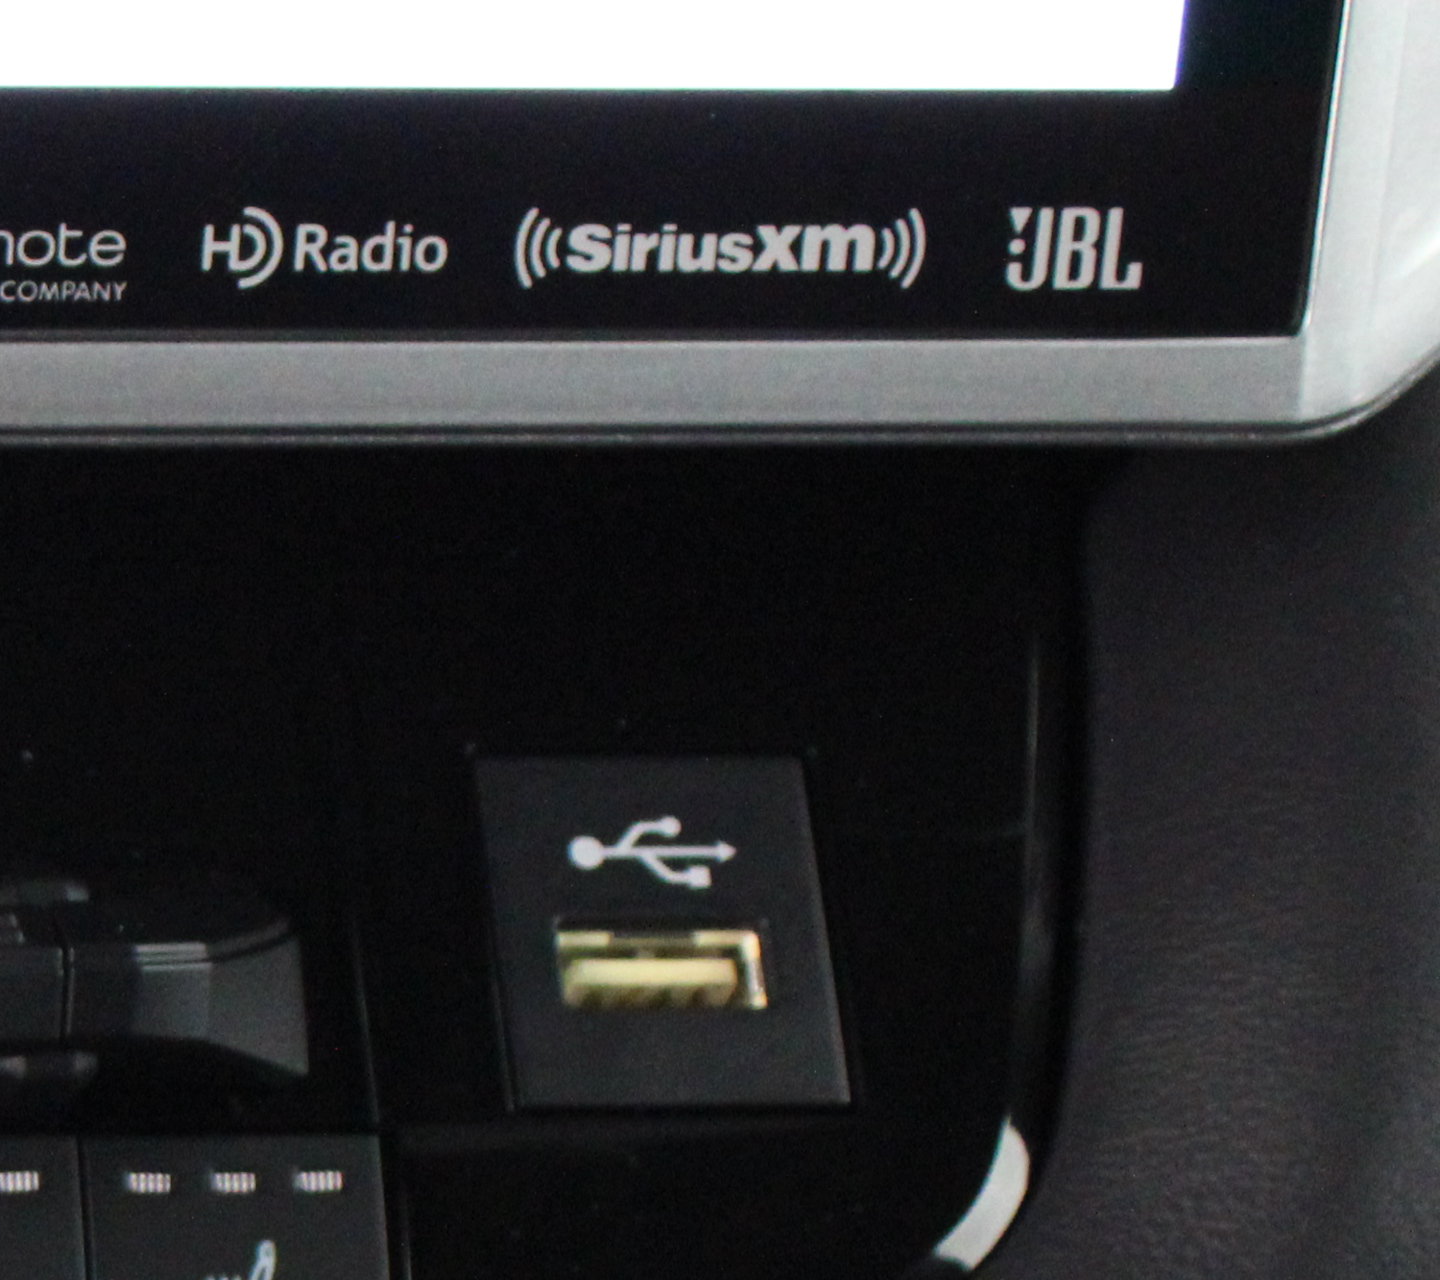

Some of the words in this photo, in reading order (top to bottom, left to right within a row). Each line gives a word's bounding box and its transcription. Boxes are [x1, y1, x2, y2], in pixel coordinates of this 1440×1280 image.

[201, 206, 284, 290] HD
[293, 220, 448, 273] Radio
[1006, 206, 1143, 291] JBL
